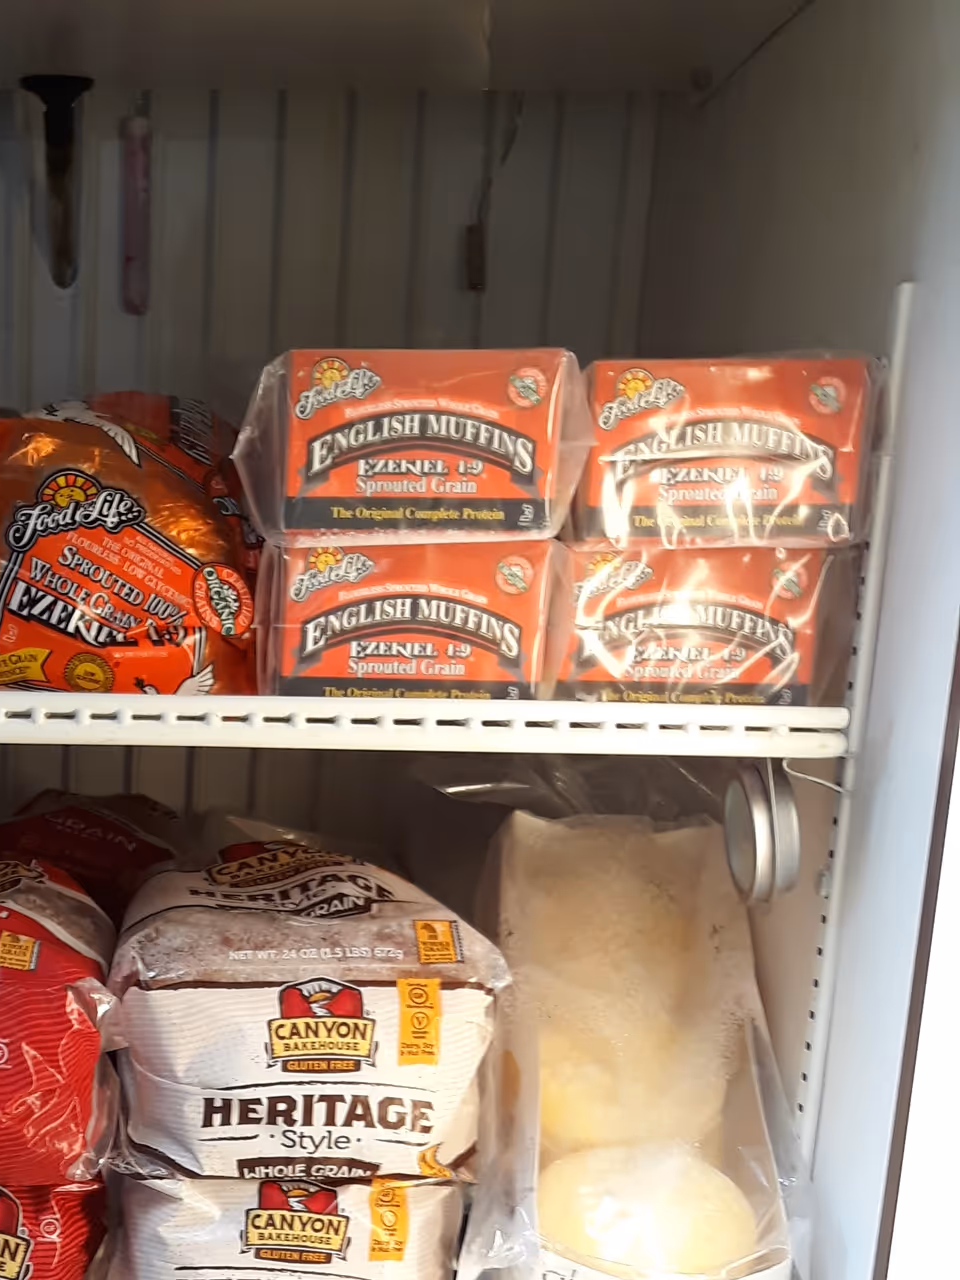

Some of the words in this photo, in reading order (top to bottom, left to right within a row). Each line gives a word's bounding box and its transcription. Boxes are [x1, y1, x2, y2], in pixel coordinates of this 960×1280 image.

[309, 413, 420, 476] ENGLISH
[427, 414, 533, 476] MUFFINS
[358, 459, 448, 476] EZEKIEL
[456, 459, 484, 474] 4:9
[356, 477, 427, 496] Sprouted
[430, 477, 477, 494] Grain
[330, 506, 354, 519] The
[355, 507, 404, 521] Original
[405, 507, 460, 521] Complete
[462, 508, 505, 521] Protein
[29, 557, 92, 608] WHOLE
[57, 545, 143, 606] SPROUTED
[203, 567, 236, 637] ORGANIC
[303, 598, 412, 658] ENGLISH
[418, 600, 520, 658] MUFFINS
[350, 641, 438, 658] EZEKIEL
[348, 659, 418, 678] Sprouted
[421, 660, 465, 676] Grain
[187, 873, 396, 904] HERITAGE
[302, 895, 368, 920] GRAIN
[274, 1019, 370, 1042] CANYON
[283, 1040, 361, 1054] BAKEHOUSE
[287, 1059, 328, 1072] GLUTEN
[329, 1059, 356, 1071] FREE
[200, 1093, 437, 1135] HERITAGE
[280, 1129, 352, 1155] Style
[242, 1162, 307, 1179] WHOLE
[311, 1164, 373, 1179] GRAIN
[250, 1213, 342, 1236] CANYON
[257, 1232, 333, 1246] BAKEHOUSE
[259, 1250, 300, 1262] GLUTEN
[301, 1251, 328, 1263] FREE
